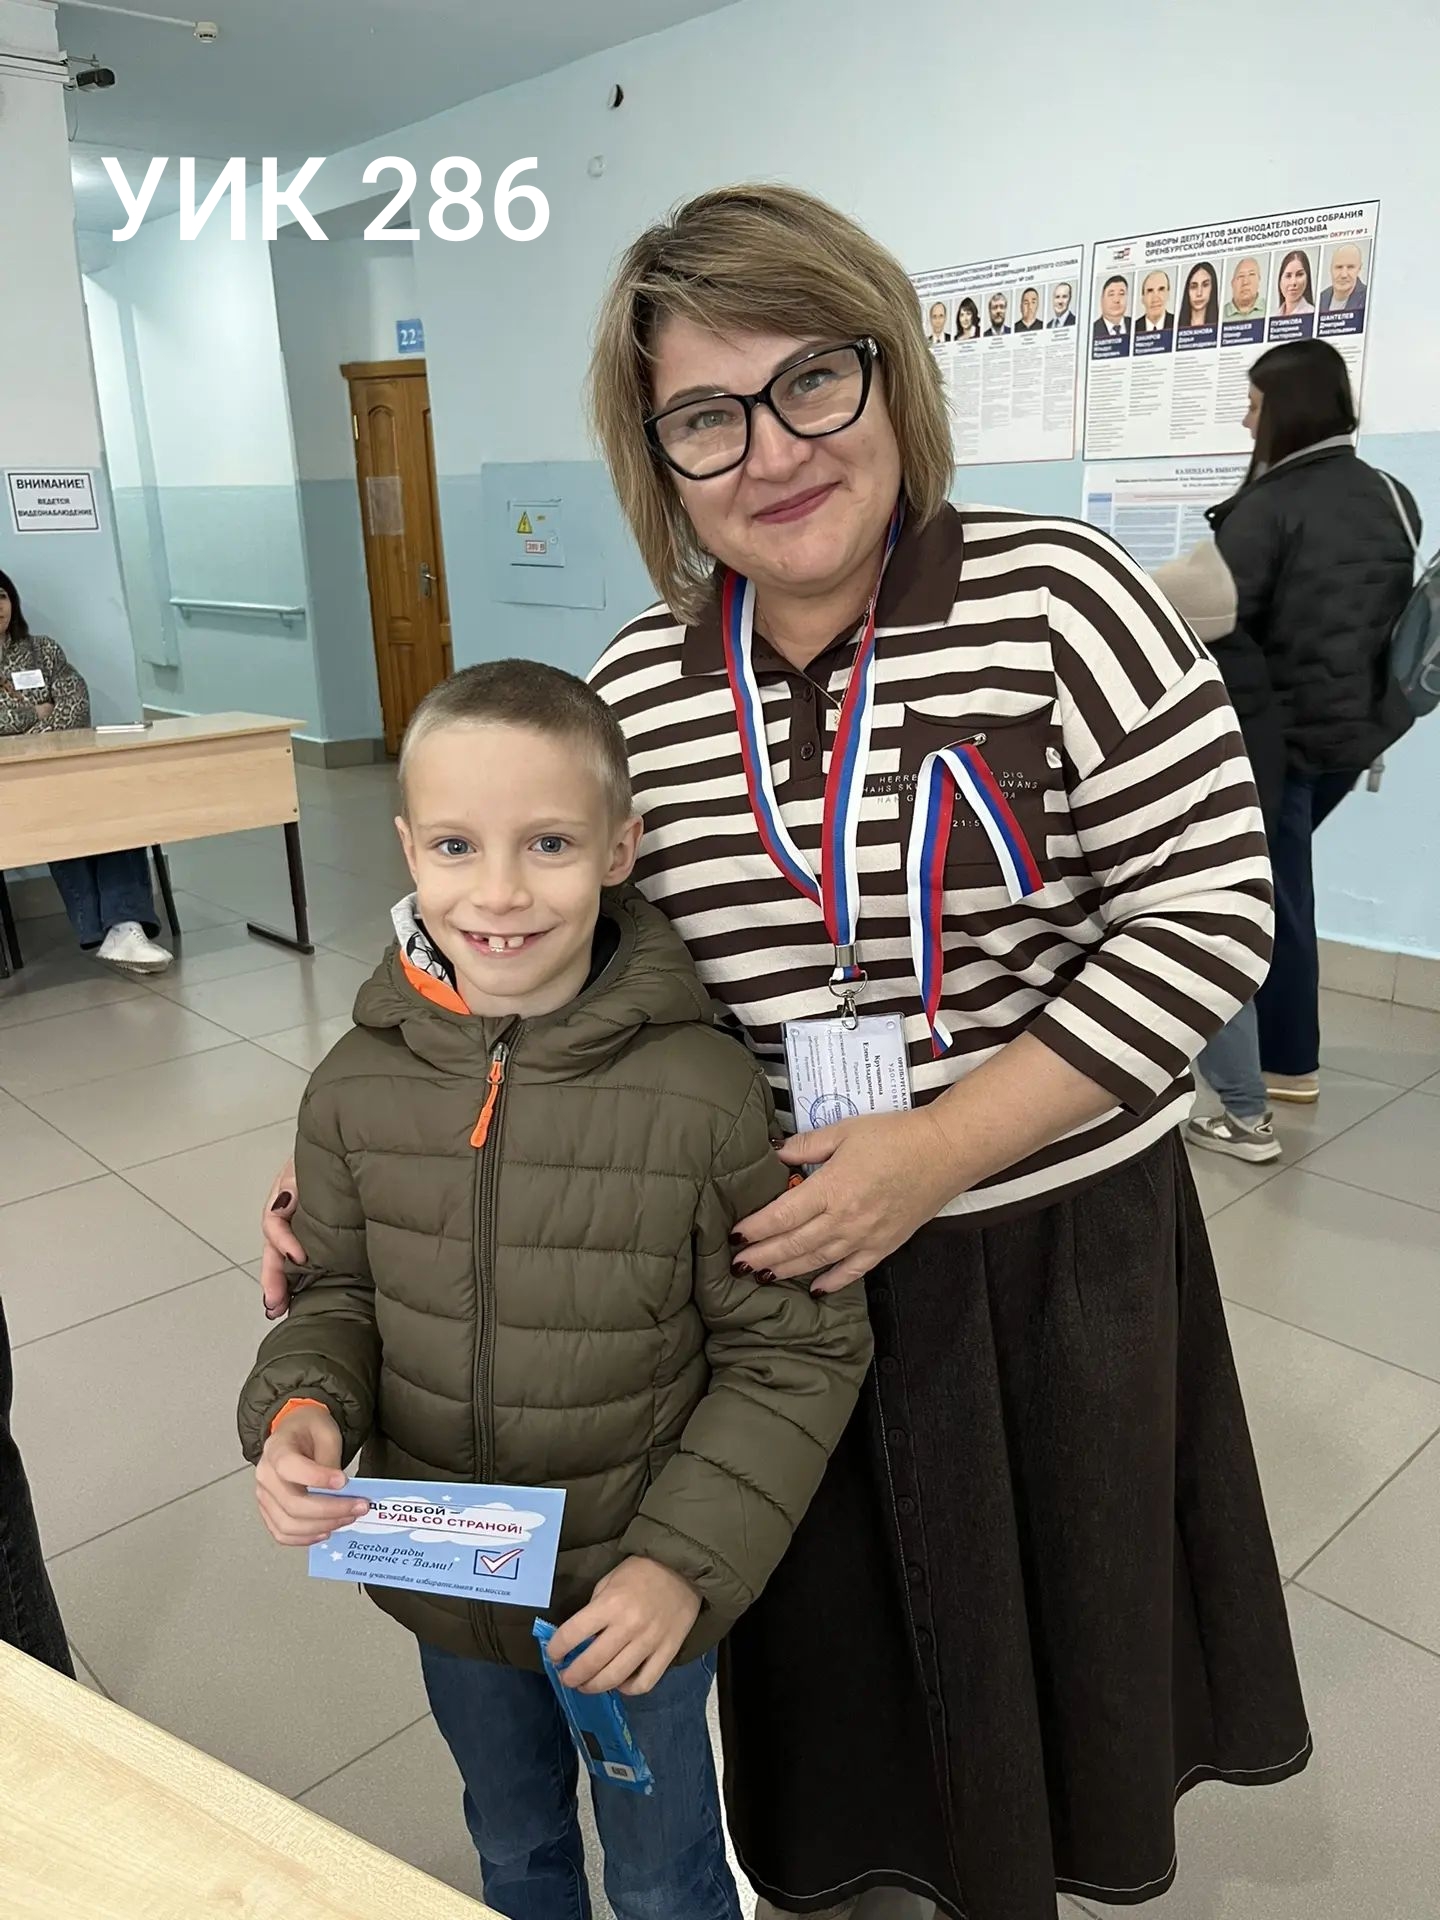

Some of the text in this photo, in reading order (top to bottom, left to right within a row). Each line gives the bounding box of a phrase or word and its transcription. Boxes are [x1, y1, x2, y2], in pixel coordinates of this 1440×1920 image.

[1145, 237, 1179, 248] ВЫБОРЫ
[1180, 229, 1226, 243] ДЕПУТАТОВ
[1227, 216, 1314, 236] ЗАКОНОДАТЕЛЬНОГО
[1316, 209, 1363, 223] СОБРАНИЯ
[1329, 230, 1355, 238] ОКРУГУ
[1145, 241, 1205, 257] ОРЕНБУРГСКОЙ
[1206, 236, 1244, 247] ОБЛАСТИ
[1246, 229, 1292, 242] ВОСЬМОГО
[1292, 224, 1328, 235] СОЗЫВА
[400, 328, 417, 345] 22
[16, 479, 84, 489] ВНИМАНИЕ!
[18, 509, 93, 517] ВИДЕОНАБЛЮДЕНИЕ
[862, 1041, 875, 1110] Елена Владимировна
[392, 1504, 446, 1516] СОБОЙ
[378, 1512, 522, 1535] БУДЬ СО СТРАНОЙ!
[348, 1540, 425, 1558] Всегда рады
[347, 1550, 399, 1565] встрече
[412, 1557, 453, 1571] Вами!
[345, 1567, 512, 1597] Ваша участковая избирательная комиссия
